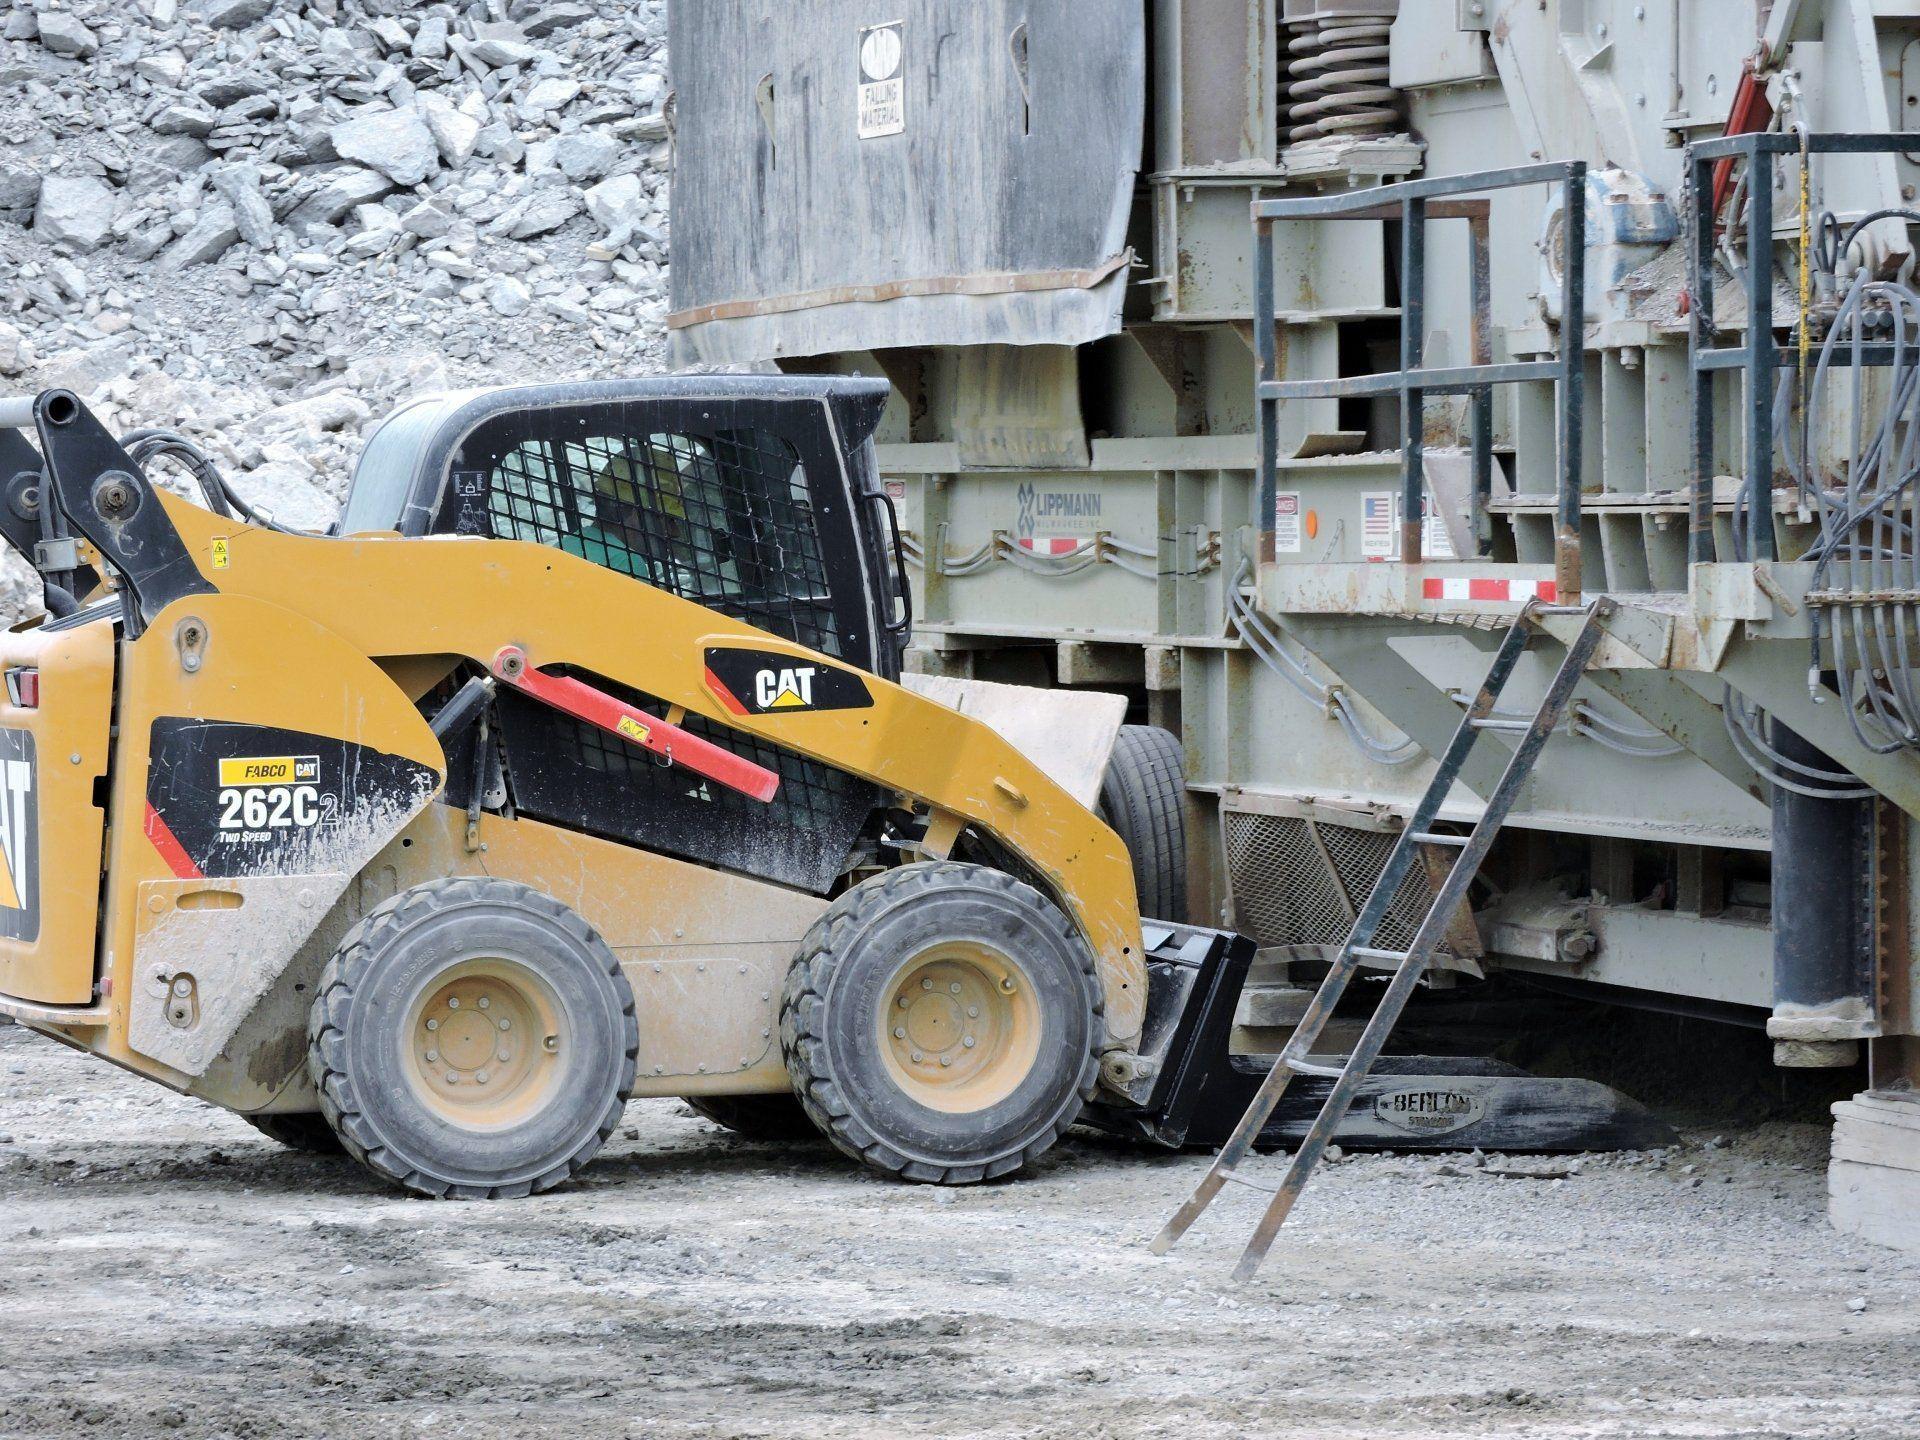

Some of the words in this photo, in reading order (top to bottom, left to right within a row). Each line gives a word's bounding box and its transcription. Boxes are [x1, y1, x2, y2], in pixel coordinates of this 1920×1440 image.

[1036, 493, 1101, 516] LIPPMANN
[755, 667, 816, 708] CAT
[245, 764, 287, 778] FABCO
[295, 763, 316, 777] CAT
[219, 831, 240, 843] TWO
[241, 830, 272, 843] SPEED
